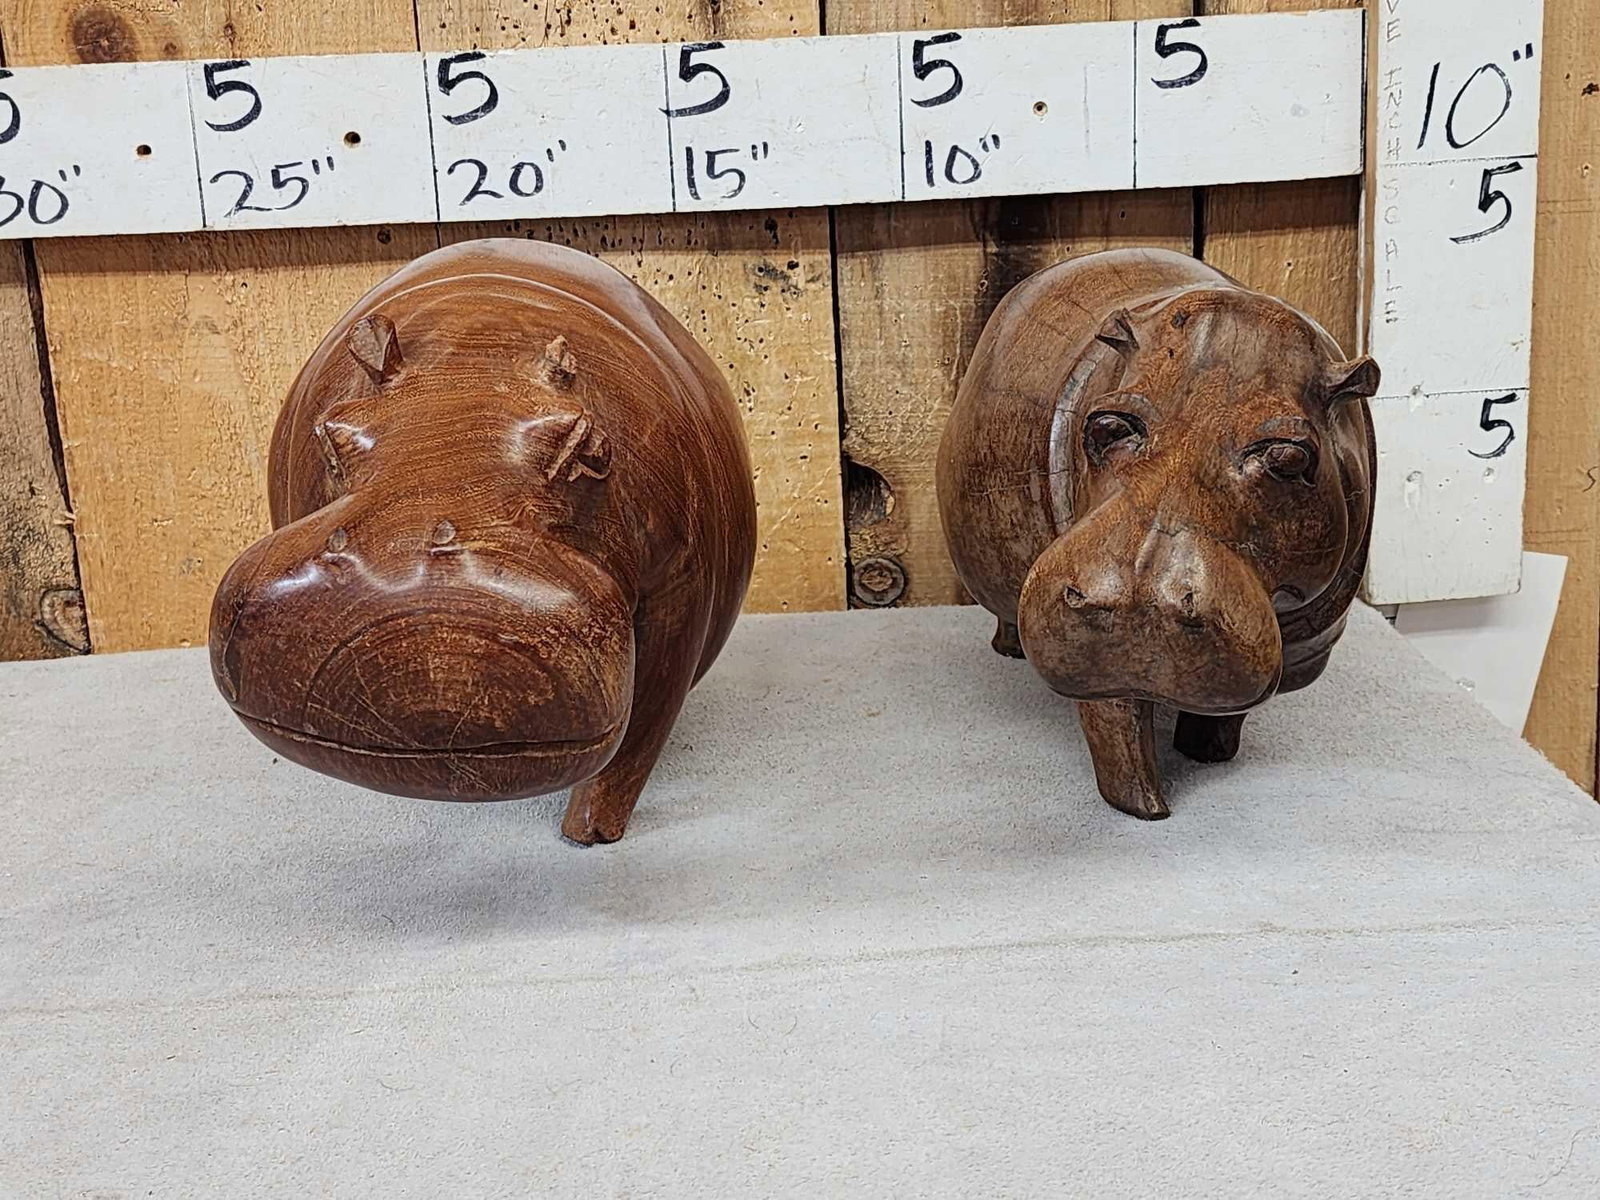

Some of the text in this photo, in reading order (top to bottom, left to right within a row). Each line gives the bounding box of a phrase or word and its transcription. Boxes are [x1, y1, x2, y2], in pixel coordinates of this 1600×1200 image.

[437, 51, 499, 125] 5
[659, 41, 731, 118] 5
[910, 32, 964, 108] 5
[1150, 18, 1208, 89] 5
[203, 59, 263, 132] 5
[1416, 42, 1534, 150] 10"
[209, 155, 335, 218] 25"
[446, 138, 567, 206] 20"
[685, 140, 769, 200] 15"
[925, 133, 1000, 188] 10"
[1449, 161, 1524, 245] 5
[1467, 391, 1521, 459] 5
